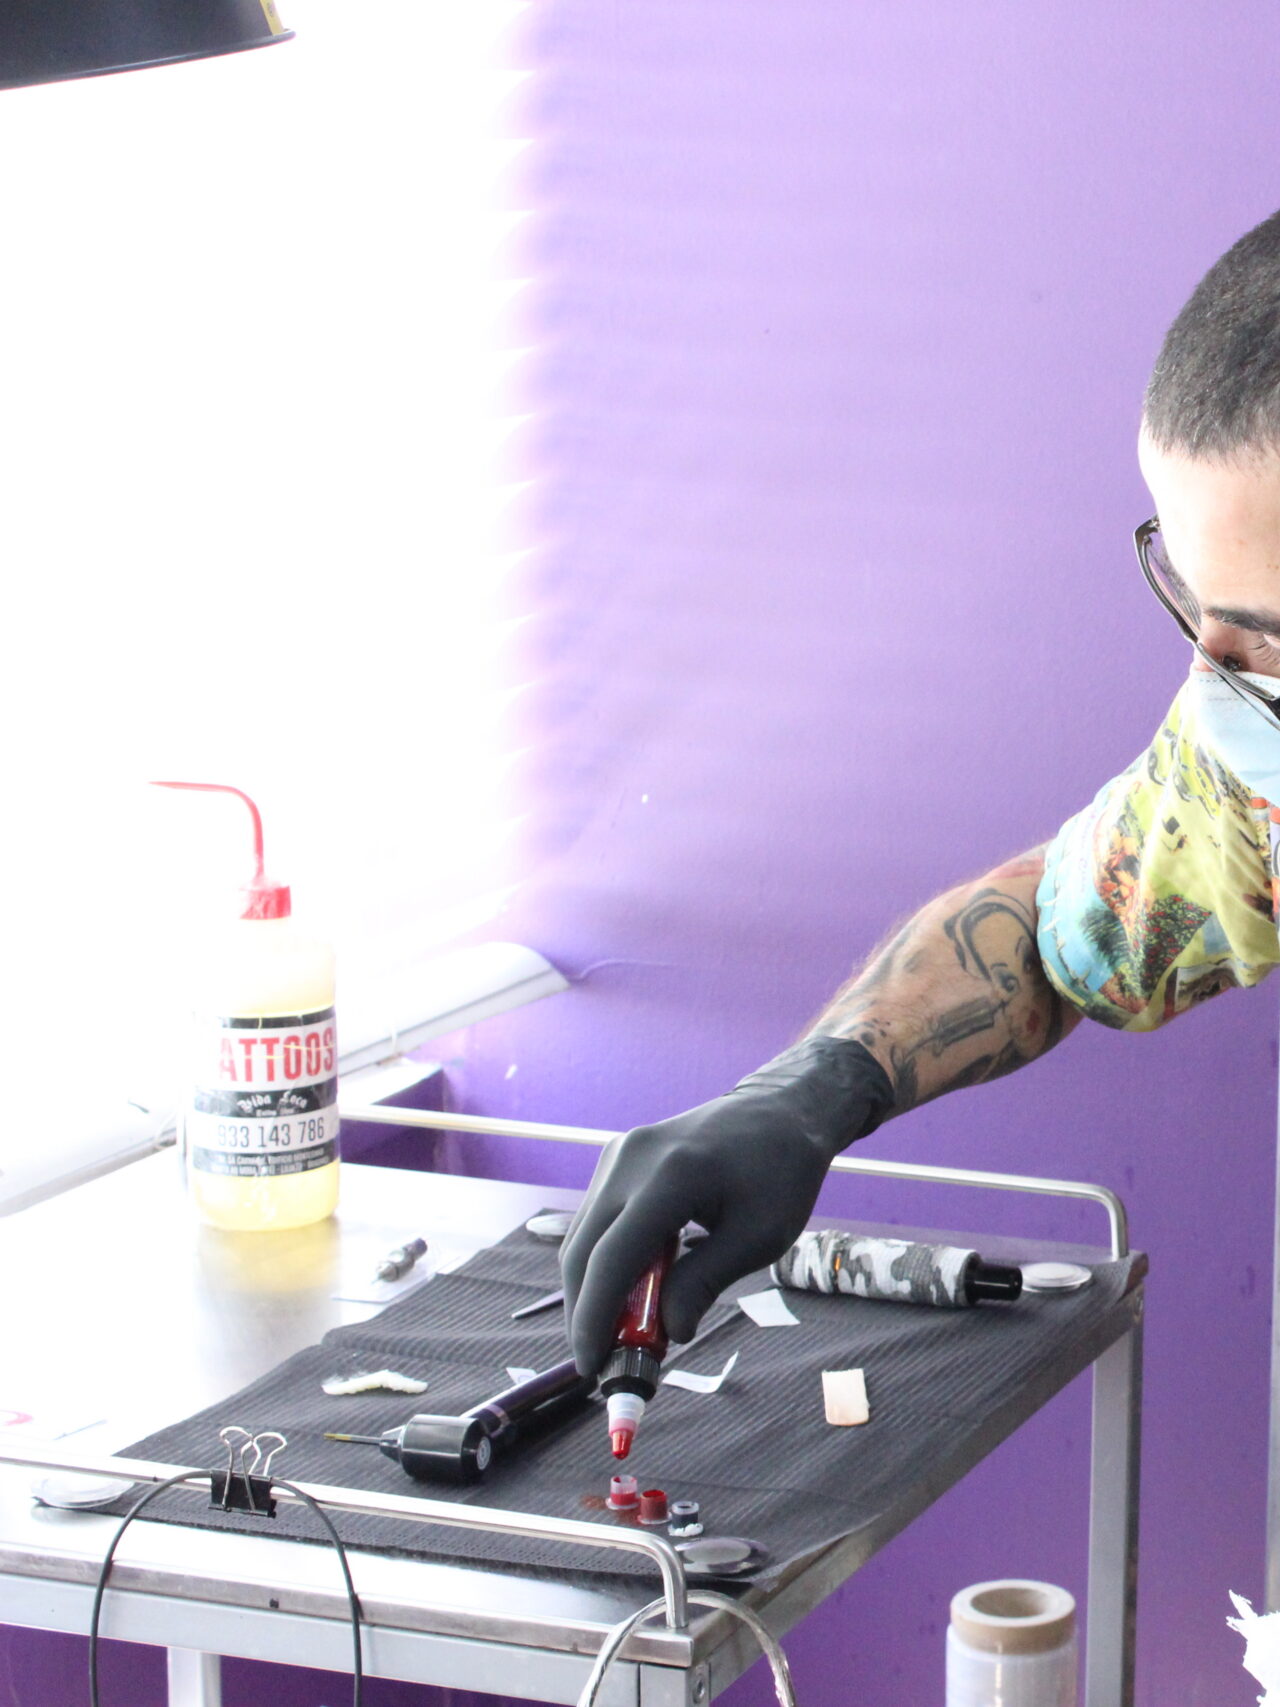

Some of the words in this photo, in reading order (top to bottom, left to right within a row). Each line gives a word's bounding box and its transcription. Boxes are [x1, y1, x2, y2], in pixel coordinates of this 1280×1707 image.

[218, 1027, 334, 1082] ATTOOS
[217, 1123, 250, 1148] 933
[257, 1123, 292, 1148] 143
[298, 1116, 325, 1143] 786
